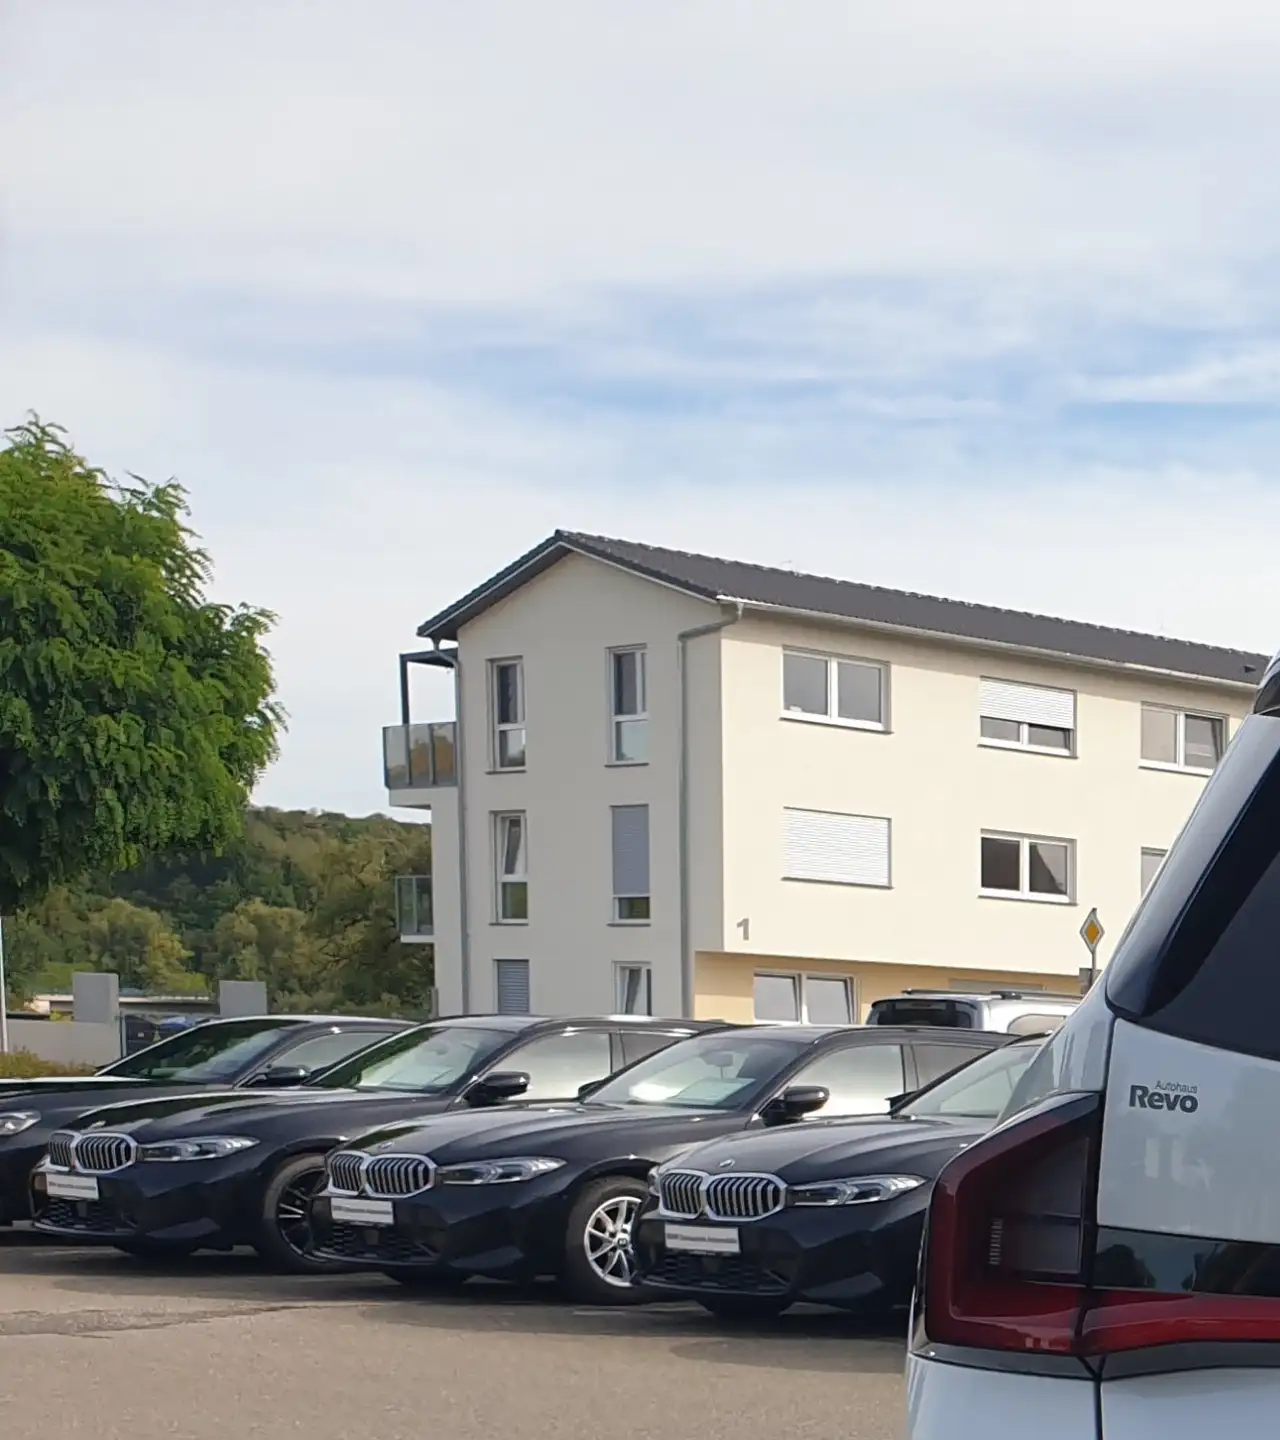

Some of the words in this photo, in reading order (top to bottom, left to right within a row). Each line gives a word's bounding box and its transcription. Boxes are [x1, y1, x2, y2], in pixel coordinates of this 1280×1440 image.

[736, 917, 750, 941] 1
[1128, 1084, 1199, 1113] Revo
[1155, 1080, 1198, 1094] Autohaus
